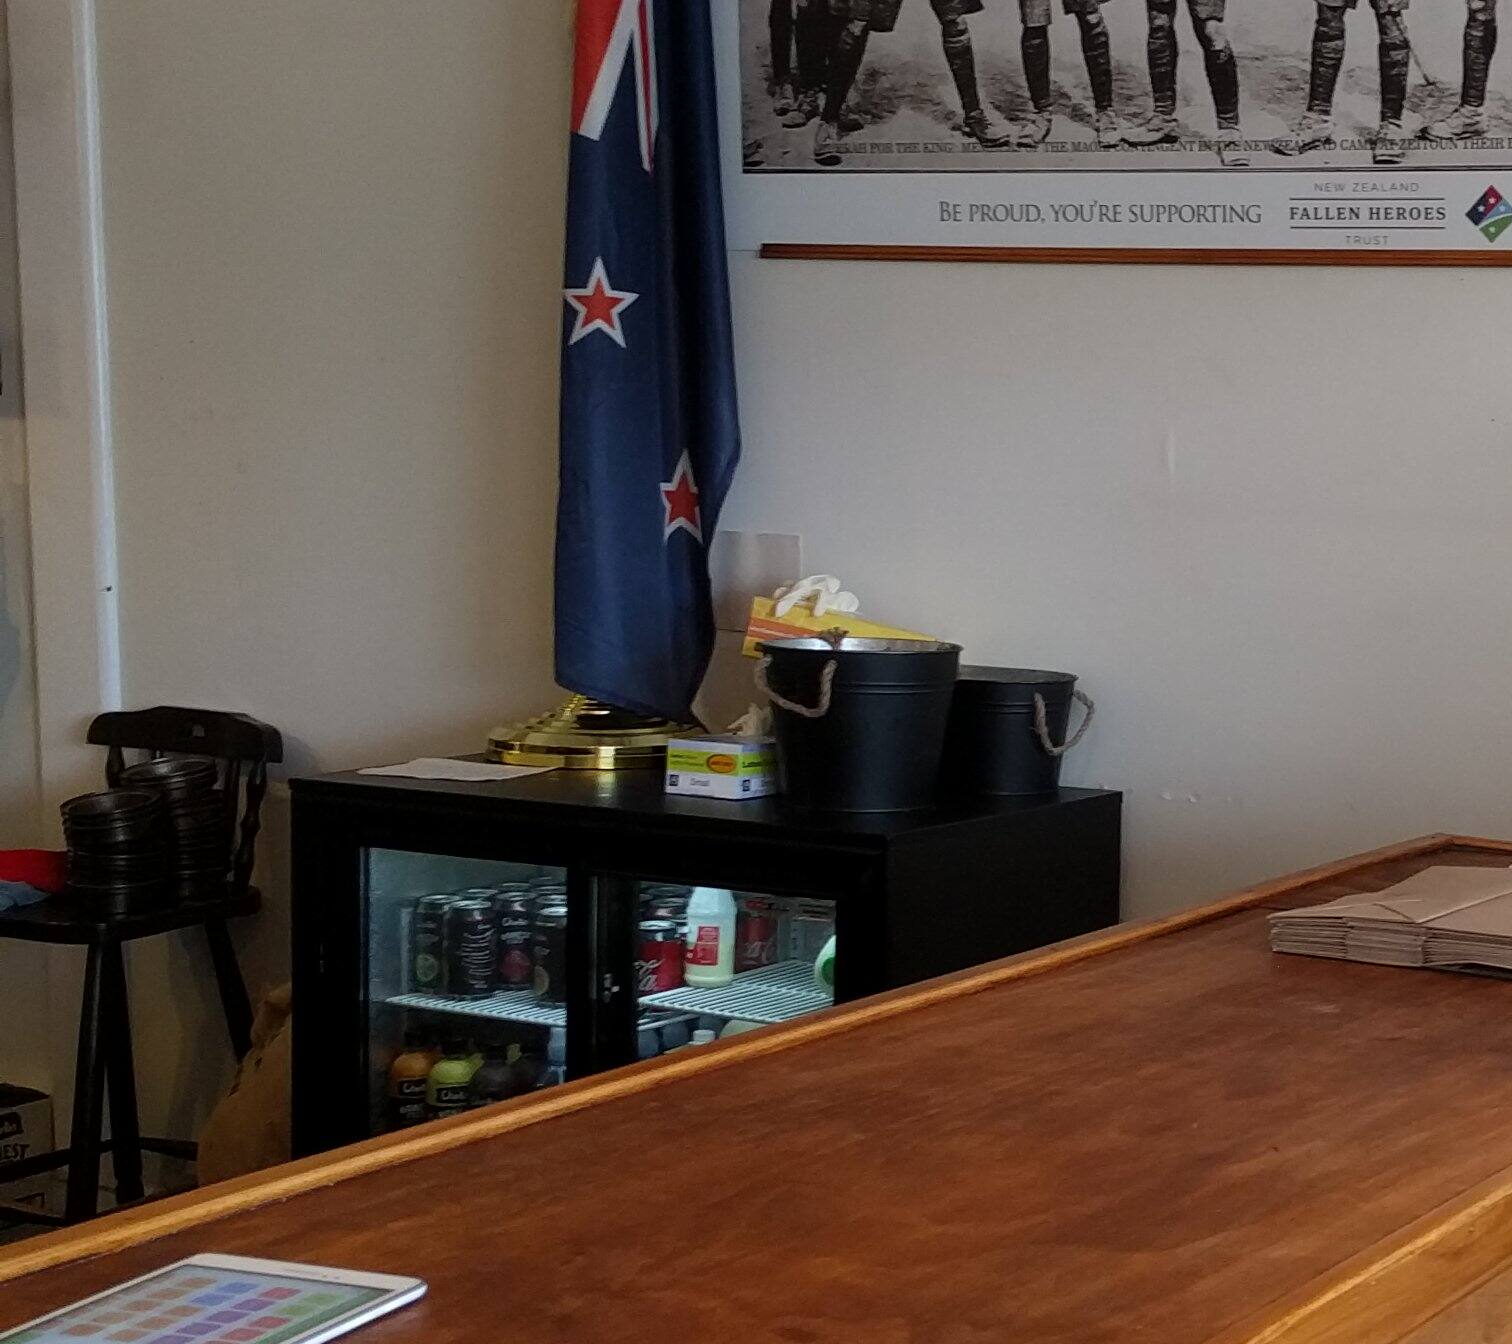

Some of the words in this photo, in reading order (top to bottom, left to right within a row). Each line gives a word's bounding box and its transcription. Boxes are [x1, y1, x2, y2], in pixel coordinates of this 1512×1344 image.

[1314, 183, 1346, 192] NEW
[1352, 182, 1420, 193] ZEALAND
[969, 204, 1045, 223] PROUD,
[1050, 200, 1122, 223] YOU'RE
[1128, 203, 1262, 224] SUPPORTING
[1289, 206, 1361, 220] FALLEN
[1368, 206, 1446, 220] HEROES
[1345, 235, 1390, 246] TRUST
